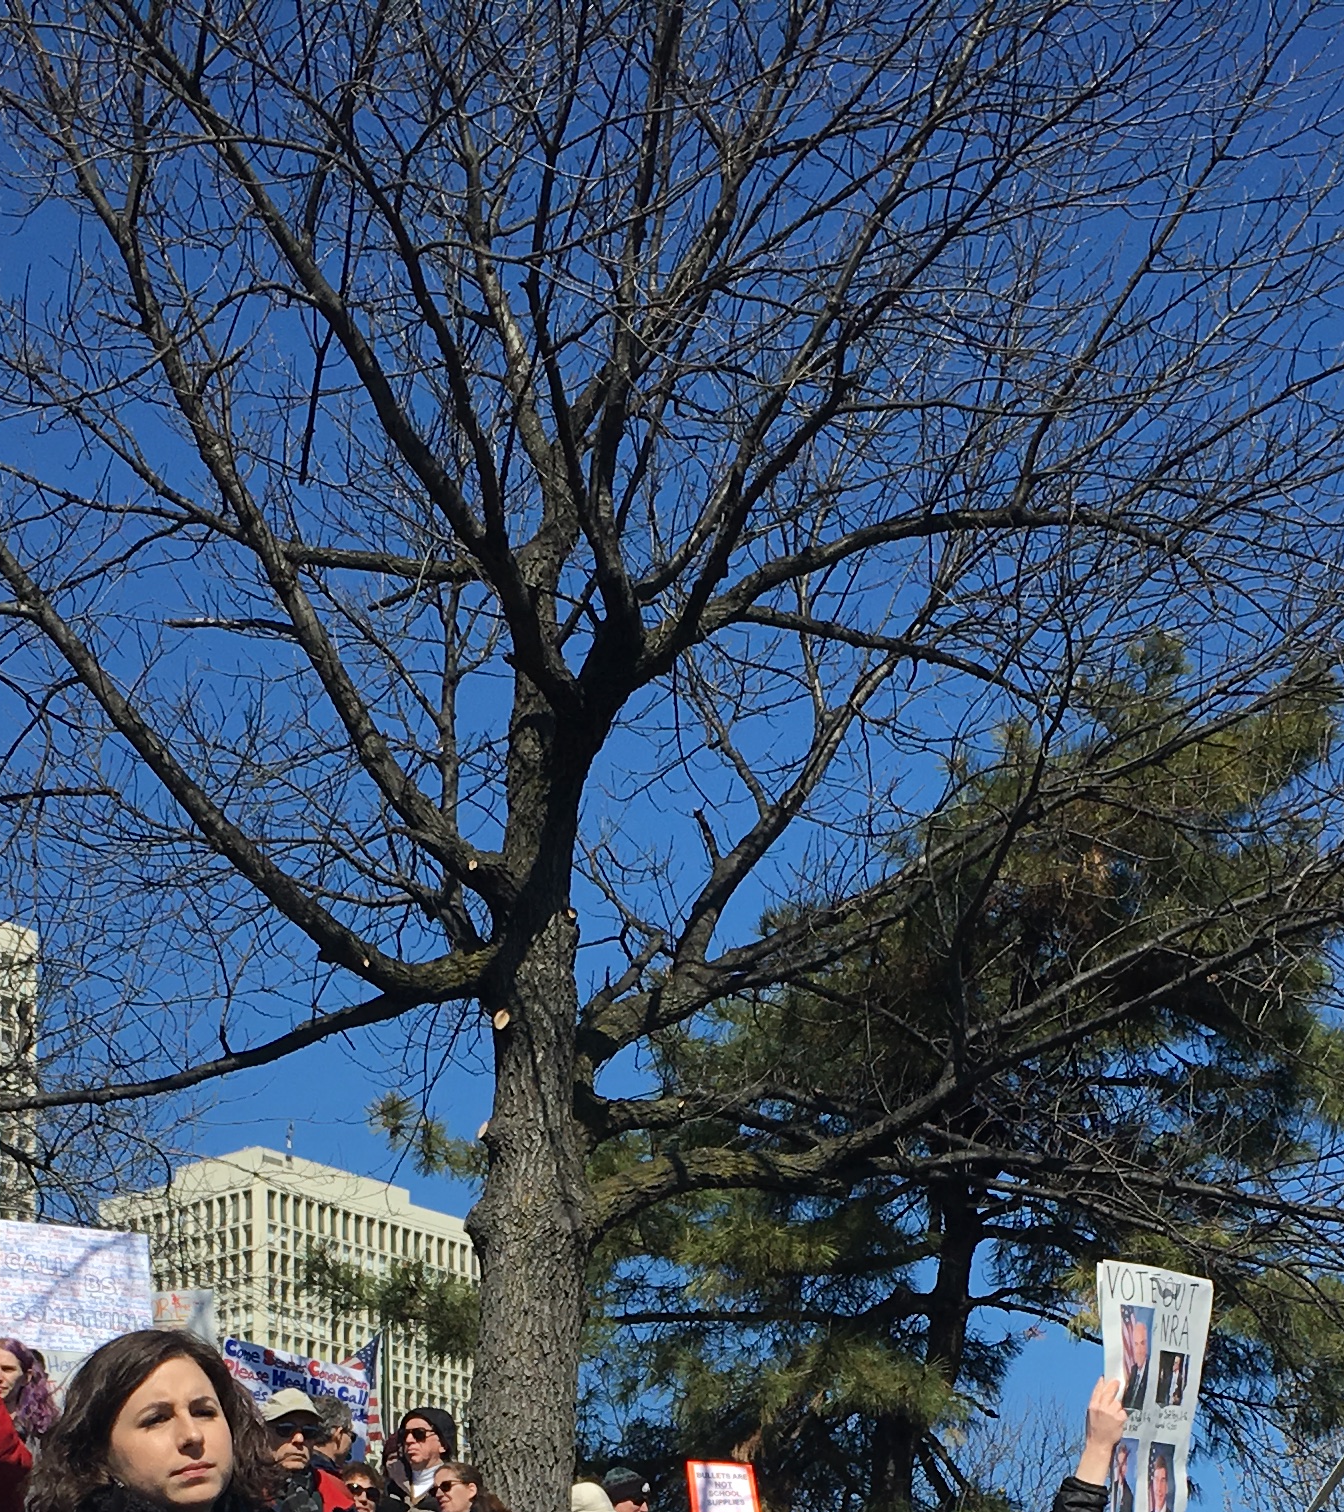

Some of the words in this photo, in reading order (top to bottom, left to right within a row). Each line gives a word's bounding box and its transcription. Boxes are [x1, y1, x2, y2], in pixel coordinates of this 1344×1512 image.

[6, 1253, 70, 1277] CALL
[1107, 1265, 1160, 1304] VOTE
[1163, 1277, 1199, 1314] OUT
[1160, 1313, 1190, 1350] NRA
[225, 1339, 261, 1363] Come
[223, 1359, 269, 1384] Please
[272, 1369, 307, 1392] Heed
[309, 1378, 336, 1397] The
[337, 1386, 369, 1406] Call
[714, 1481, 733, 1489] NOT
